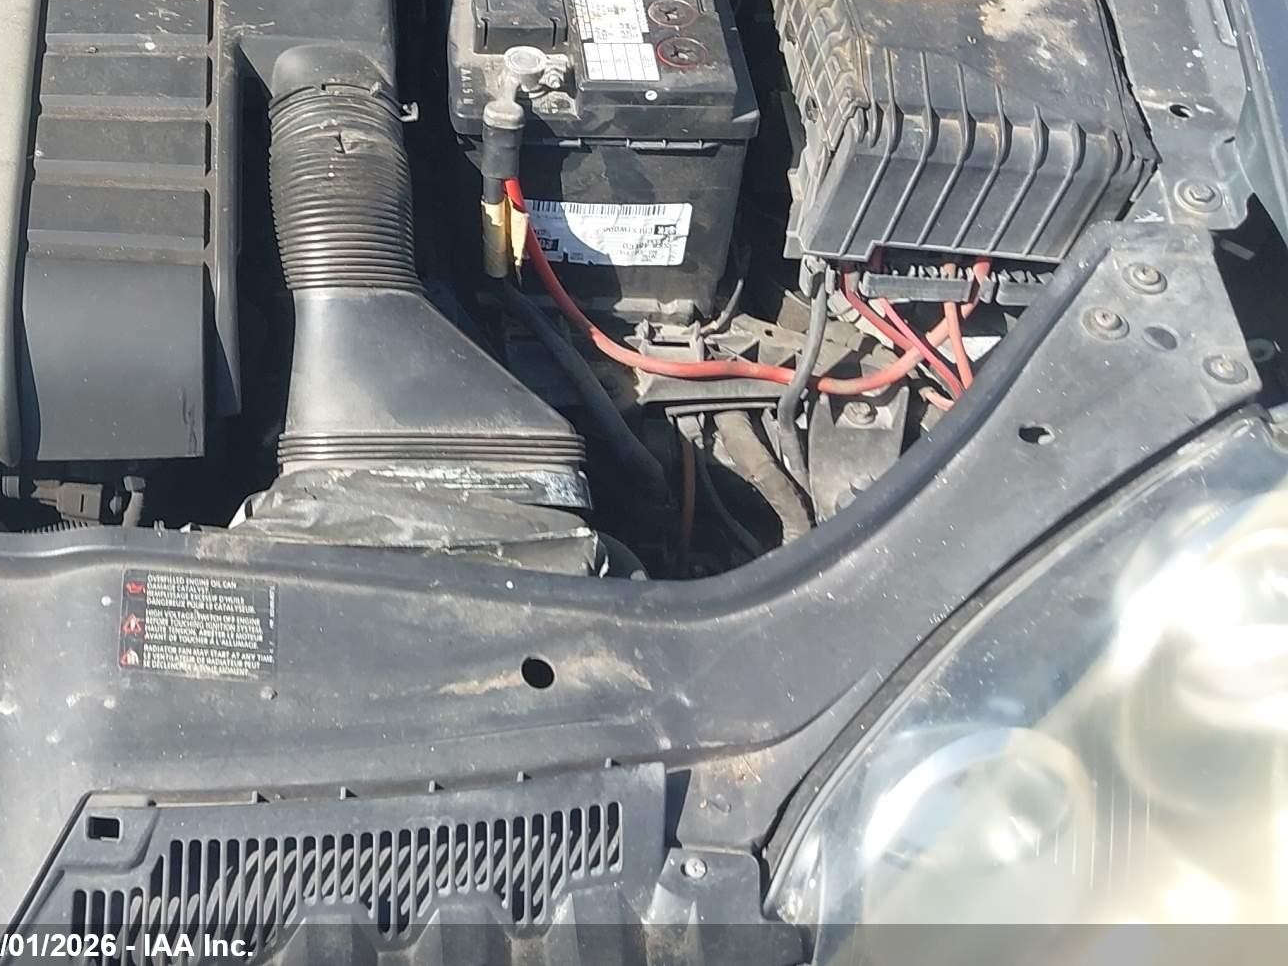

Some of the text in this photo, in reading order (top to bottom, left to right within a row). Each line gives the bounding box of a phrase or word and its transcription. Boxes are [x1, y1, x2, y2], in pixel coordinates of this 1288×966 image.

[147, 574, 185, 585] OVERFILLED
[186, 577, 210, 587] ENGINE
[222, 580, 237, 589] CAN
[147, 582, 175, 592] DAMAGE
[147, 597, 186, 608] DANGEREUX
[186, 600, 204, 609] POUR
[145, 609, 163, 617] HIGH
[236, 616, 261, 625] ENGINE
[145, 617, 169, 626] BEFORE
[170, 619, 204, 629] TOUCHING
[205, 621, 235, 631] IGNITION
[145, 625, 167, 634] HAUTE
[235, 631, 263, 641] MOTEUR
[145, 632, 168, 642] AVANT
[179, 635, 209, 645] TOUCHER
[143, 644, 177, 655] RADIATOR
[210, 649, 230, 659] START
[152, 653, 196, 664] VENTILATEUR
[205, 657, 243, 668] RADIATEUR
[243, 660, 261, 669] PEUT
